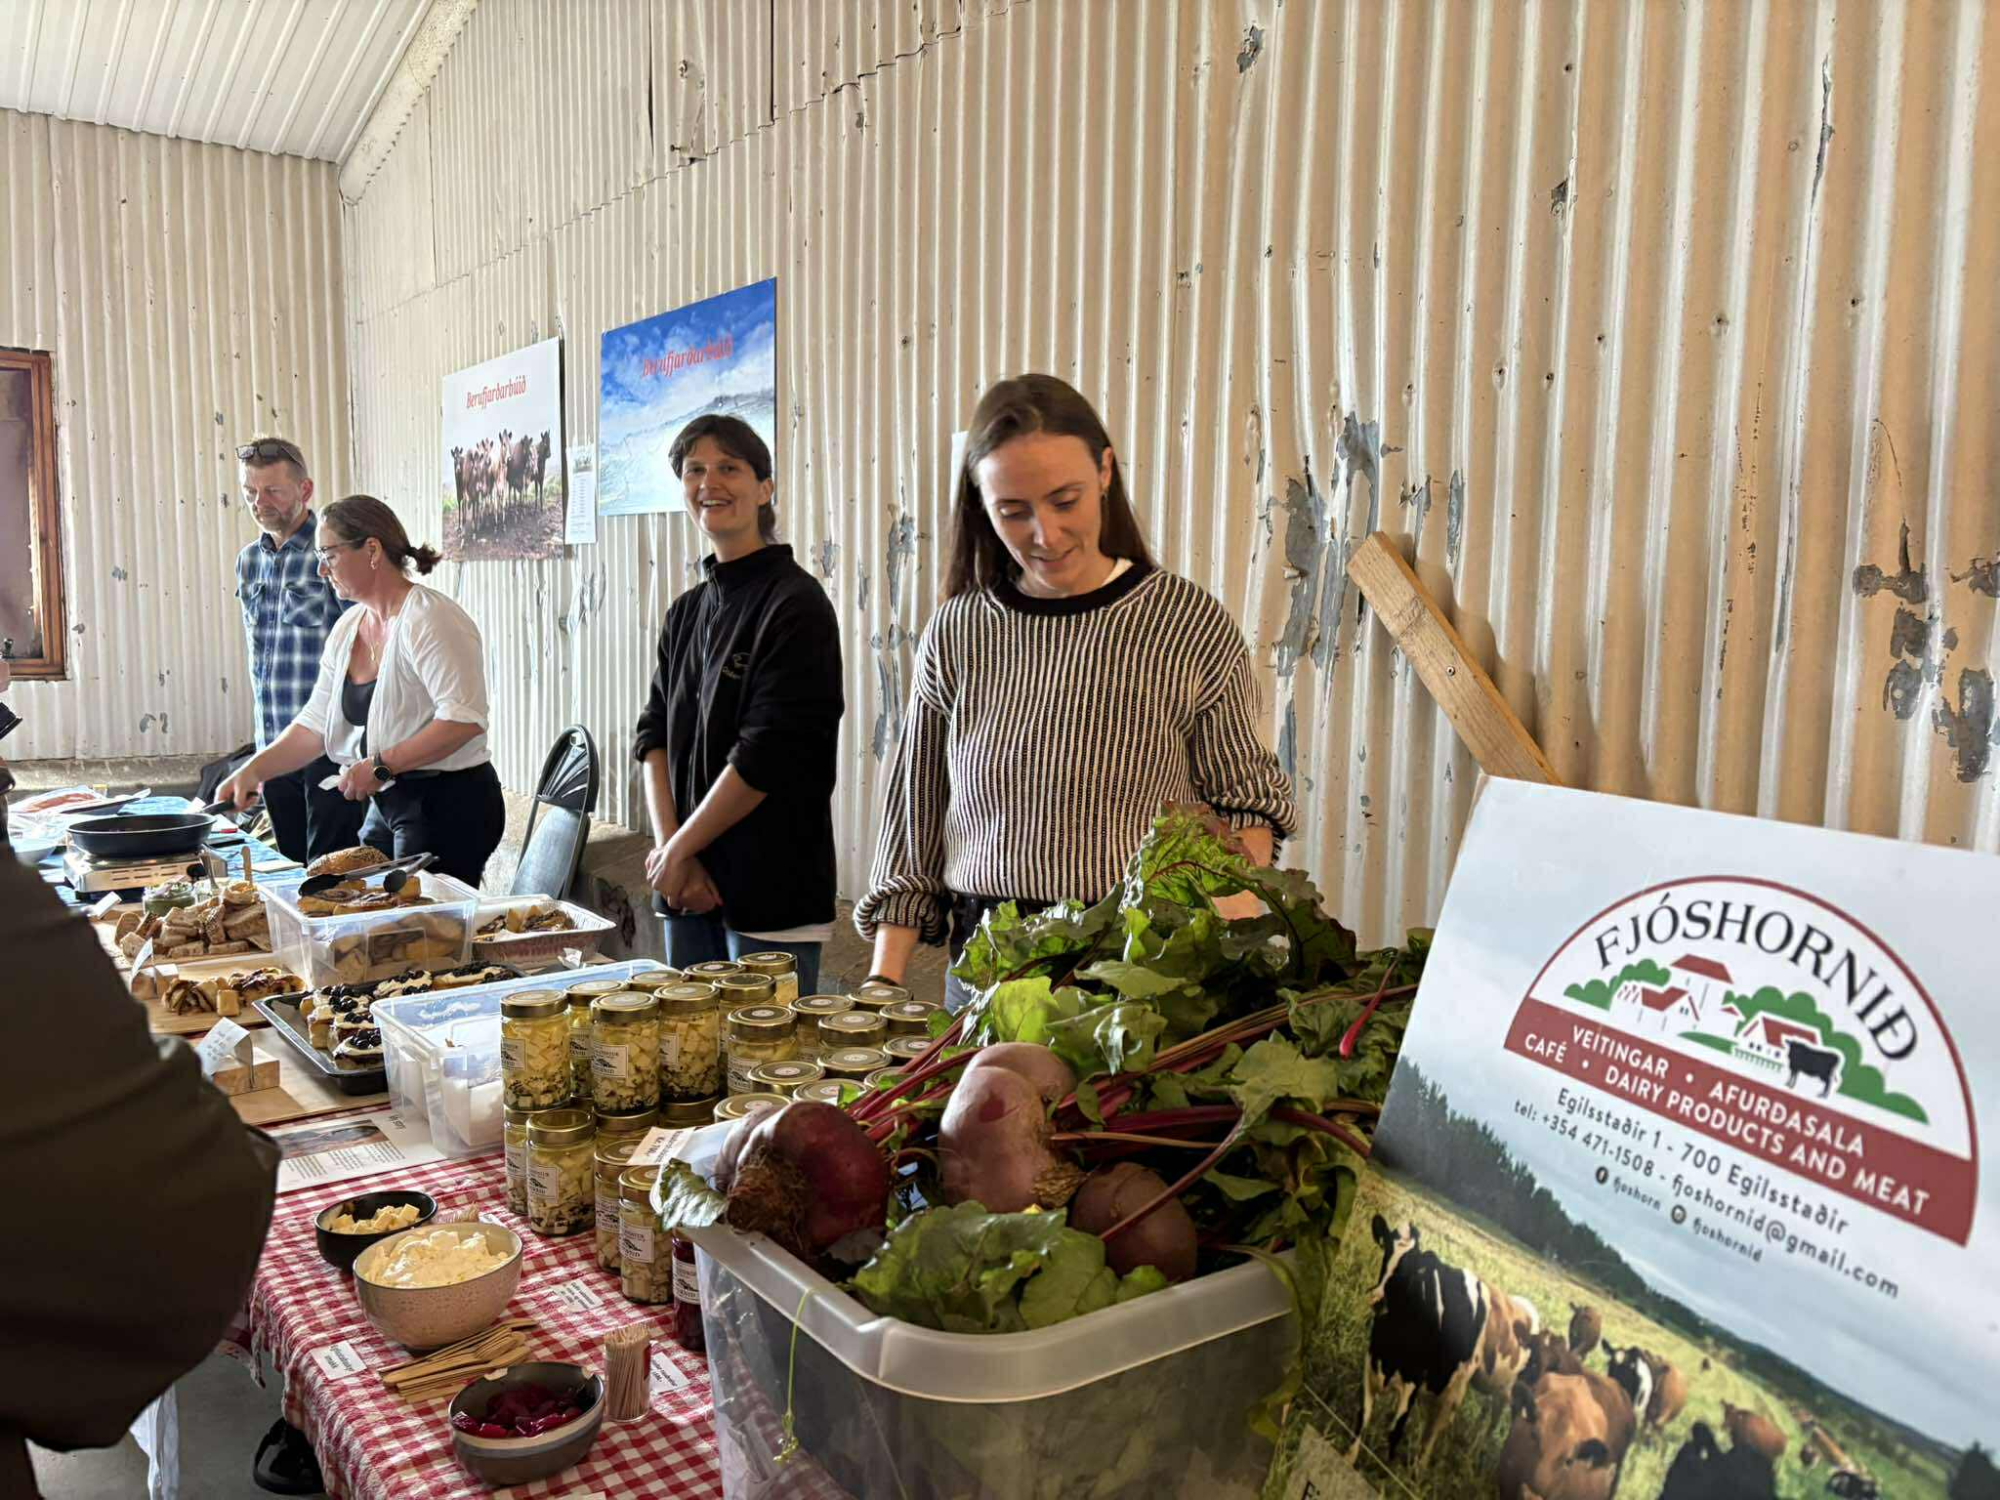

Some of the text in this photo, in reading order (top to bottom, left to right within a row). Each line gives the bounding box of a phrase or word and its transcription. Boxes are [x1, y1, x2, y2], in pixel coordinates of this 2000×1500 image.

[1594, 891, 1918, 1061] FJÓSHORNIÐ
[1524, 1033, 1930, 1216] CAFÉ DAIRY PRODUCTS AND MEAT
[1557, 1088, 1647, 1142] Egilsstaðir
[1652, 1130, 1662, 1149] 1
[1680, 1142, 1721, 1175] 700
[1727, 1164, 1849, 1235] Egilsstaðir
[1572, 1024, 1864, 1158] VEITINGAR AFURÐASALA
[1513, 1099, 1538, 1122] tel:
[1541, 1114, 1578, 1140] +354
[1582, 1132, 1655, 1177] 471-1508
[1672, 1174, 1899, 1299] fjoshornid@gmail.com
[1693, 1218, 1763, 1263] fjoshornid
